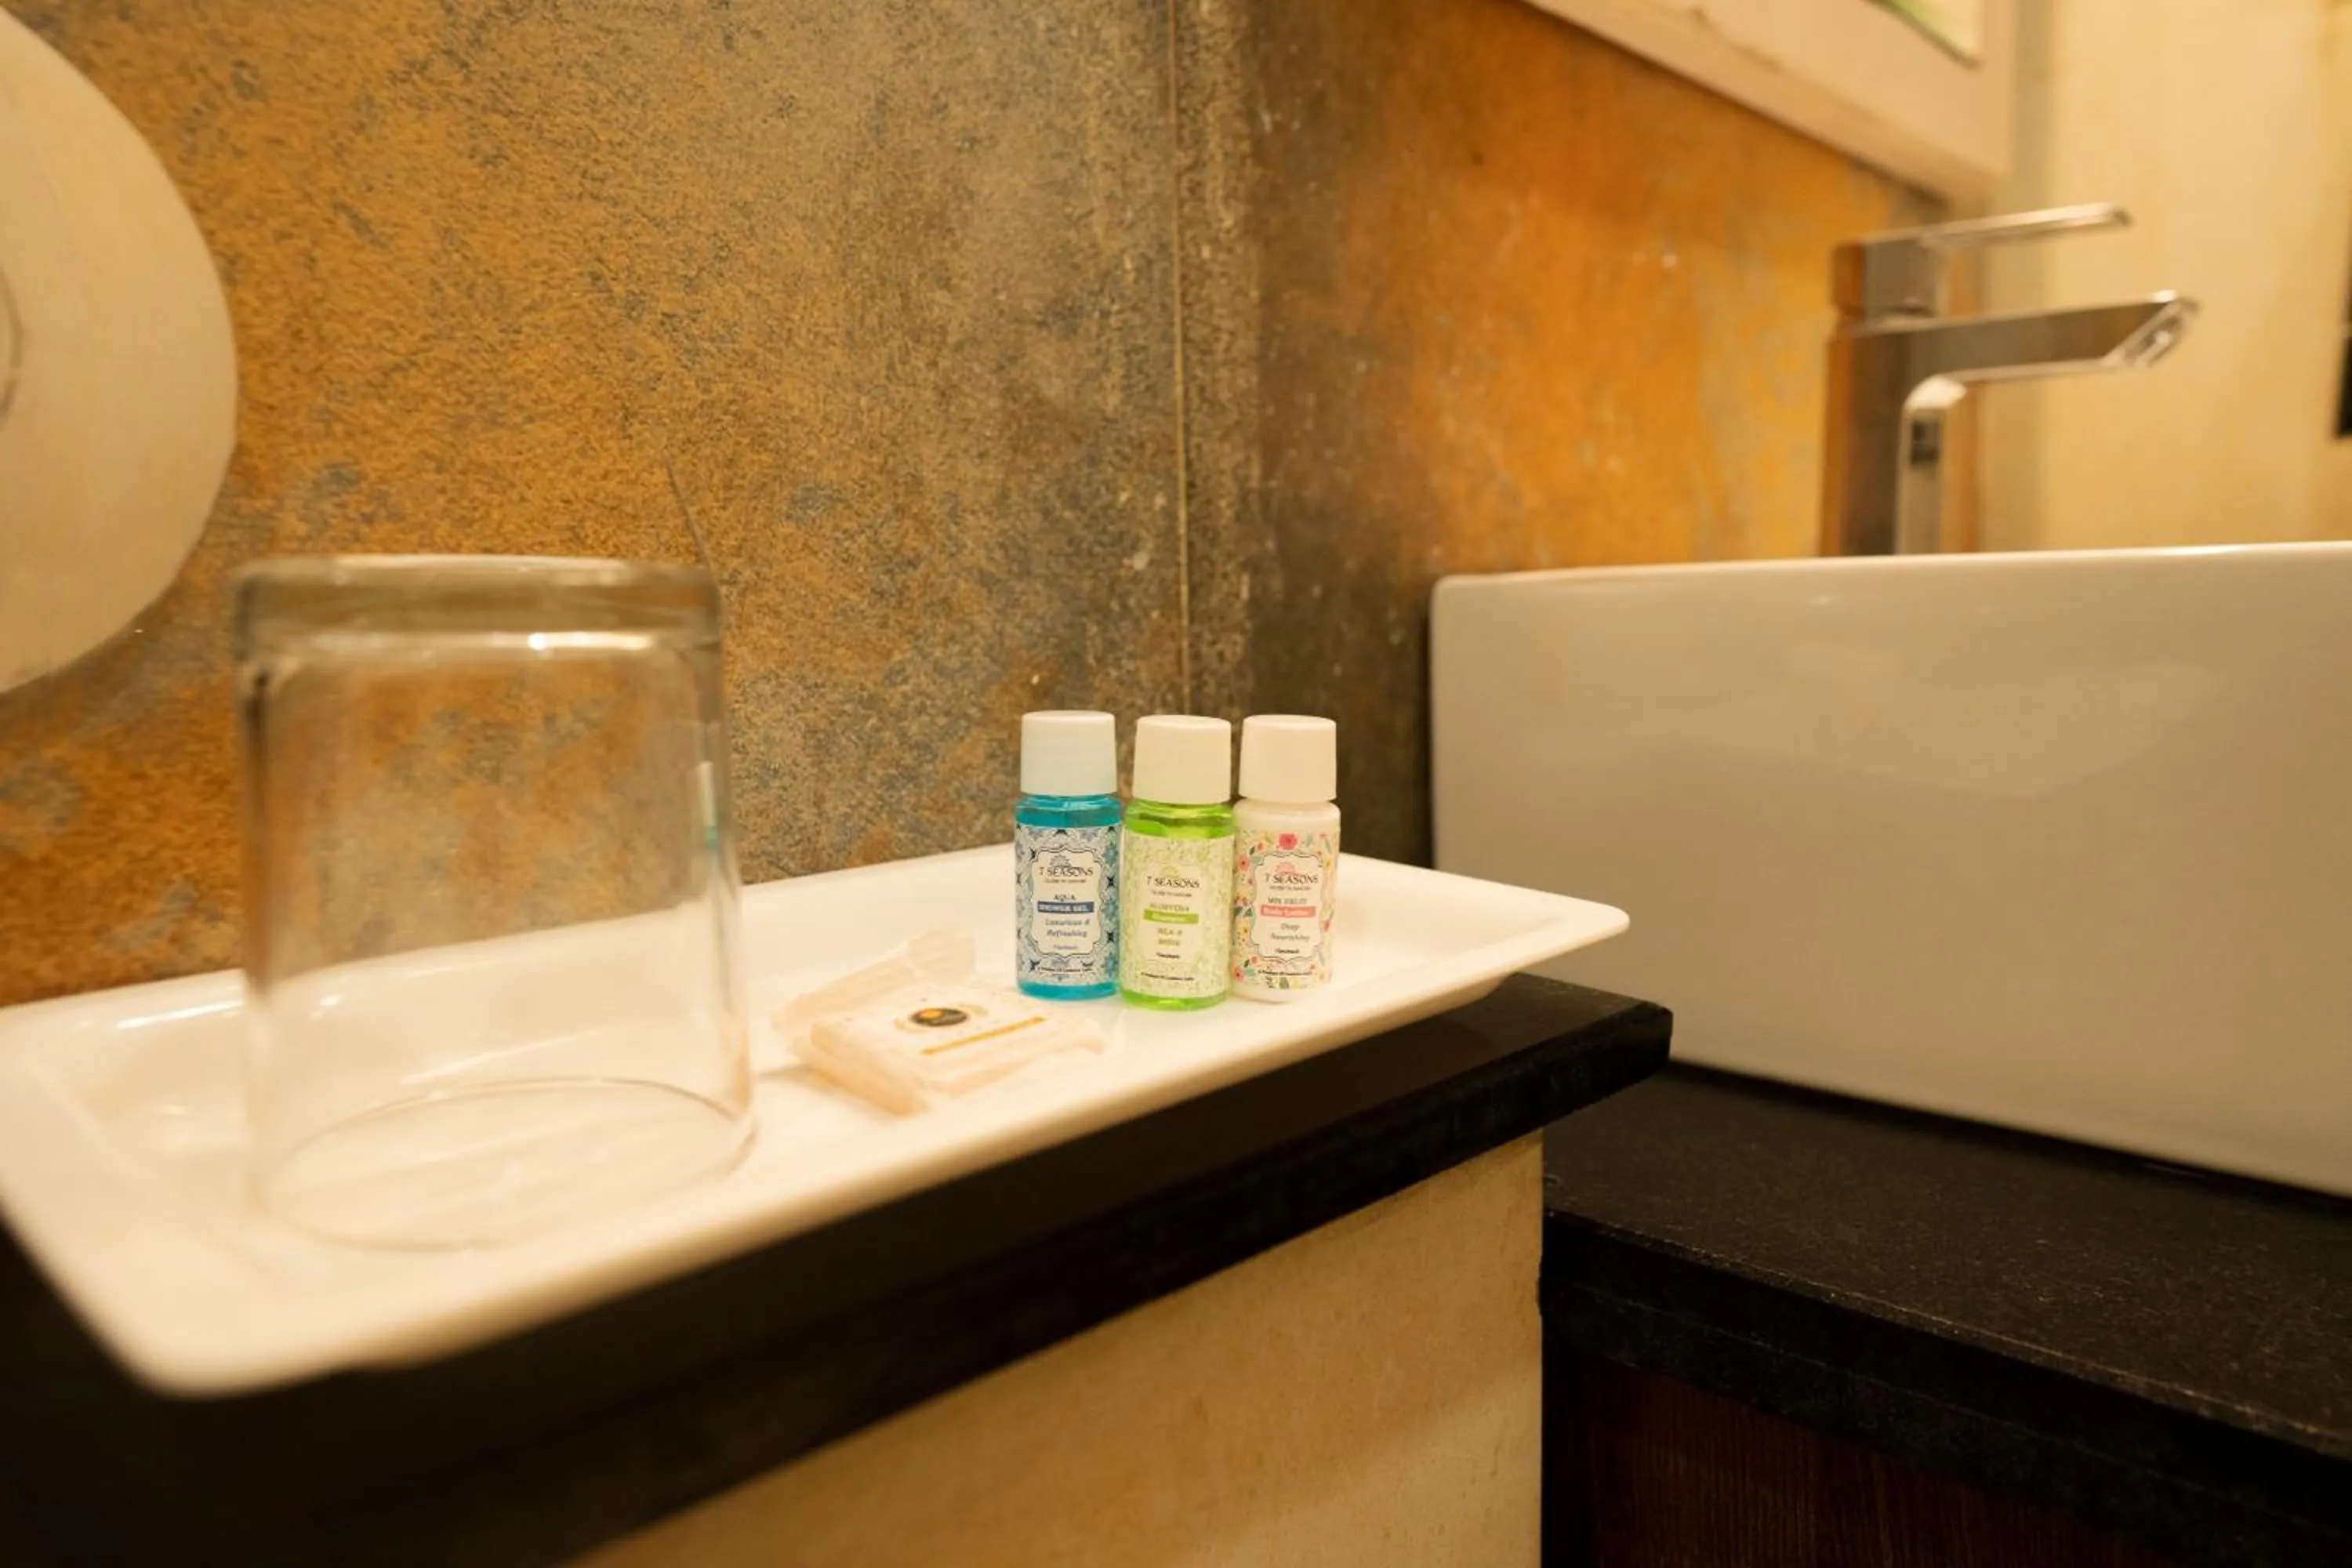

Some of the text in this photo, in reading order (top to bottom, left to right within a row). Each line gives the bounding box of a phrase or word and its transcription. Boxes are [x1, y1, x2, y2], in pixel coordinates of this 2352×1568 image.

[1039, 866, 1094, 877] 7 SEASONS
[1147, 876, 1200, 888] 7 SEASONS
[1273, 873, 1318, 884] SEASONS
